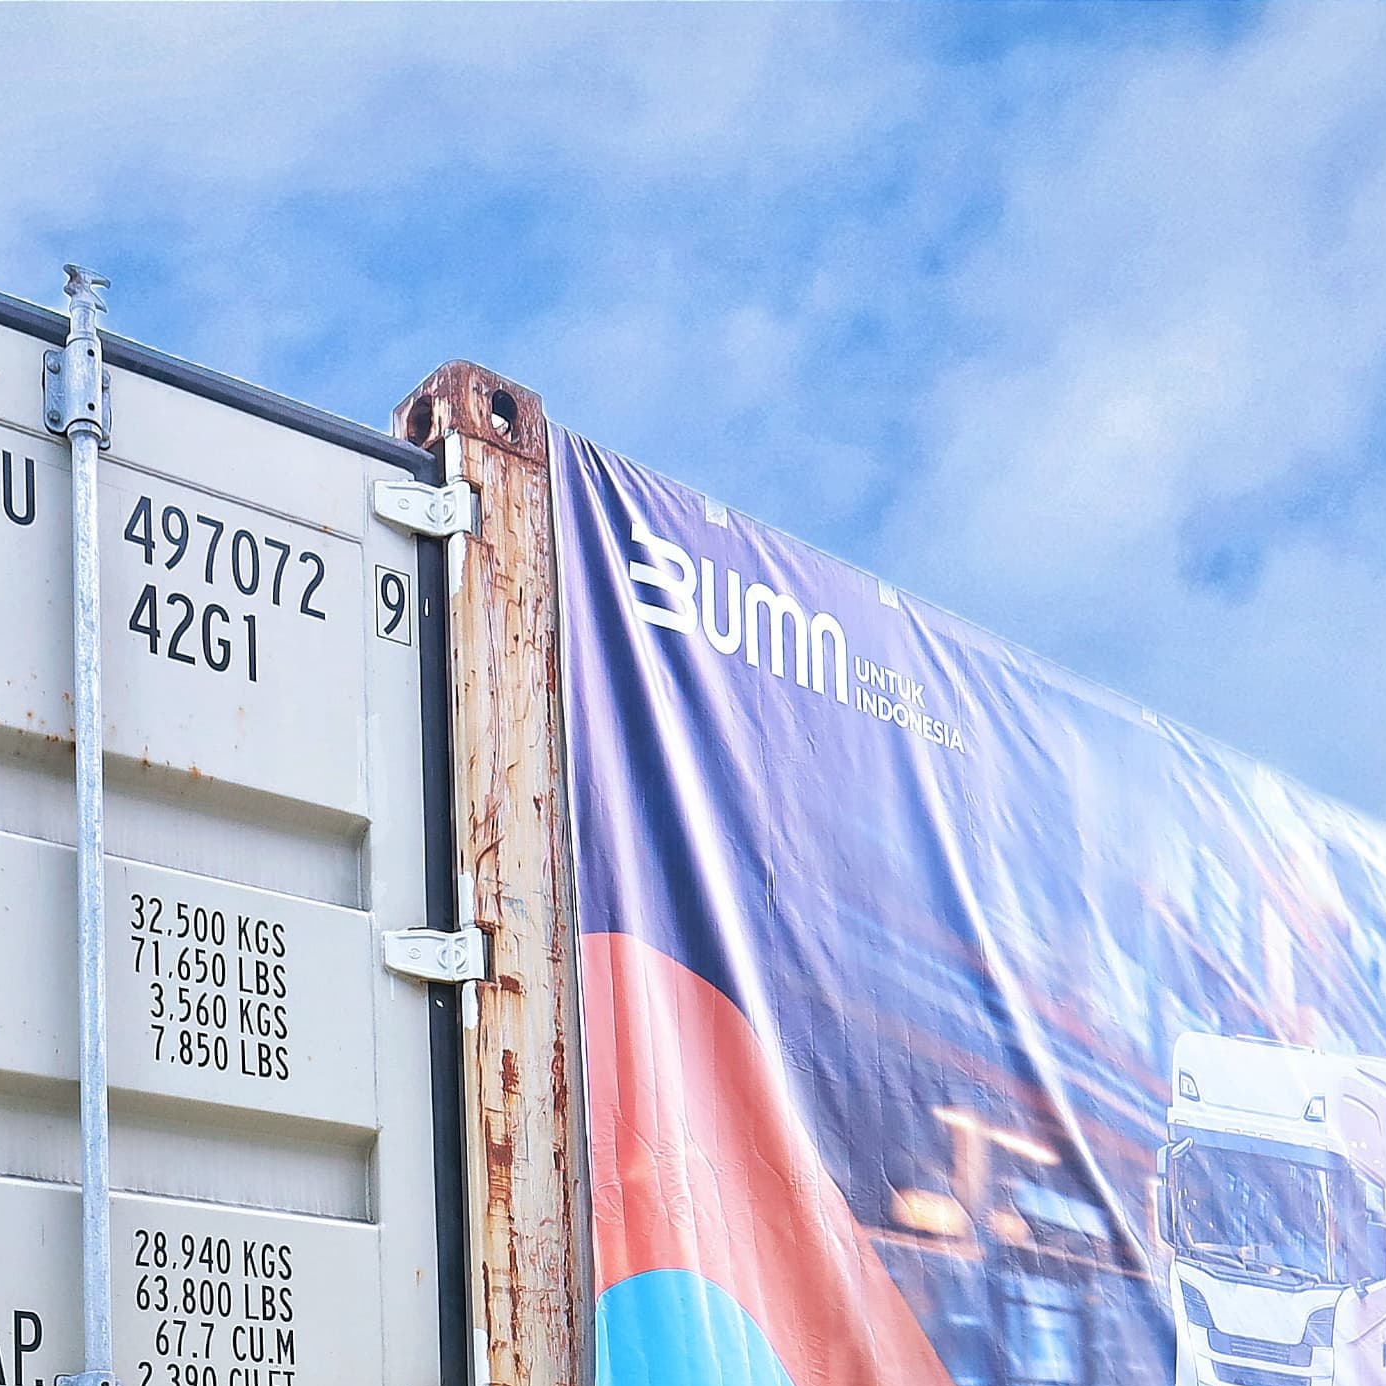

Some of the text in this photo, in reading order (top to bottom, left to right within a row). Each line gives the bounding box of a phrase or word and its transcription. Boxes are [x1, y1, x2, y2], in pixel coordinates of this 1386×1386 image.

[124, 496, 407, 635] 497072 9
[129, 584, 258, 682] 42G1
[630, 522, 849, 705] BUMN
[855, 655, 926, 709] UNTUK
[855, 688, 966, 753] INDONESIA
[237, 914, 287, 958] KGS
[238, 956, 288, 999] LBS
[239, 998, 288, 1041] KGS
[240, 1039, 290, 1081] LBS
[243, 1240, 294, 1281] KGS
[244, 1283, 294, 1323] LBS
[156, 1320, 296, 1366] 67.7 CU.M
